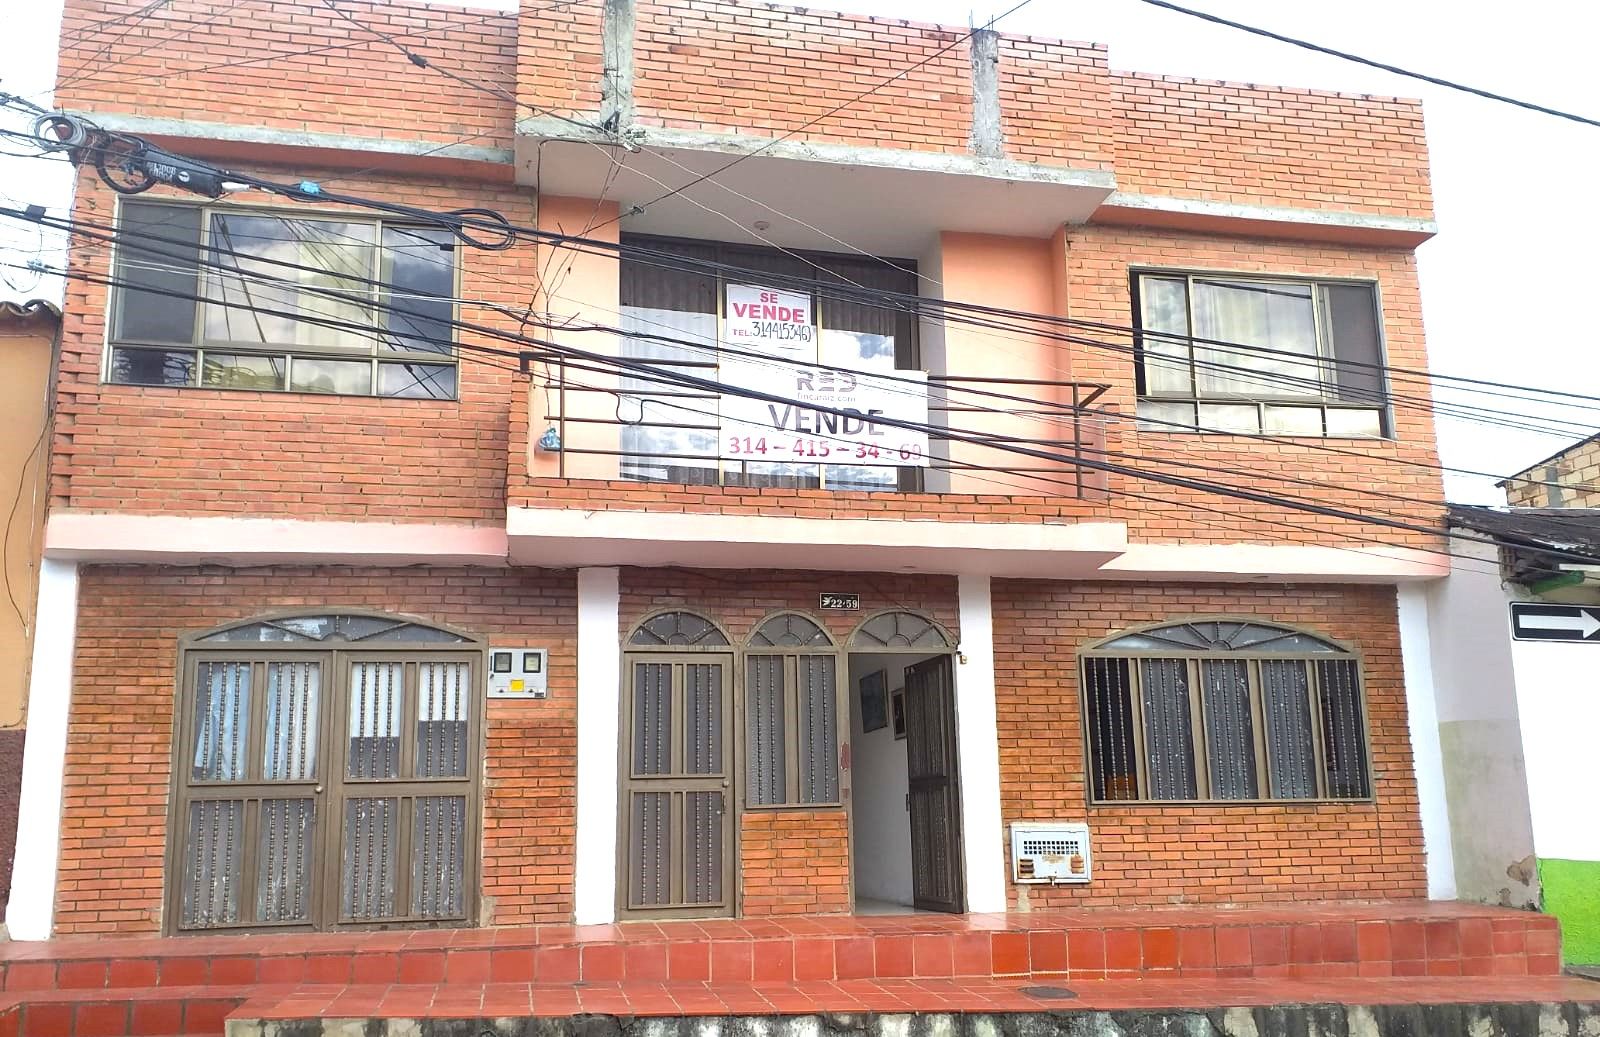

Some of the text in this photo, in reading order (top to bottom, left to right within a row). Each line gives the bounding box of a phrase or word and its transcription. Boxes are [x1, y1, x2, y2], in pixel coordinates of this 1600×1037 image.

[760, 291, 778, 304] SE
[732, 302, 805, 324] VENDE
[768, 404, 885, 436] VENDE
[729, 437, 768, 455] 314
[792, 438, 830, 458] 415
[855, 441, 880, 460] 34
